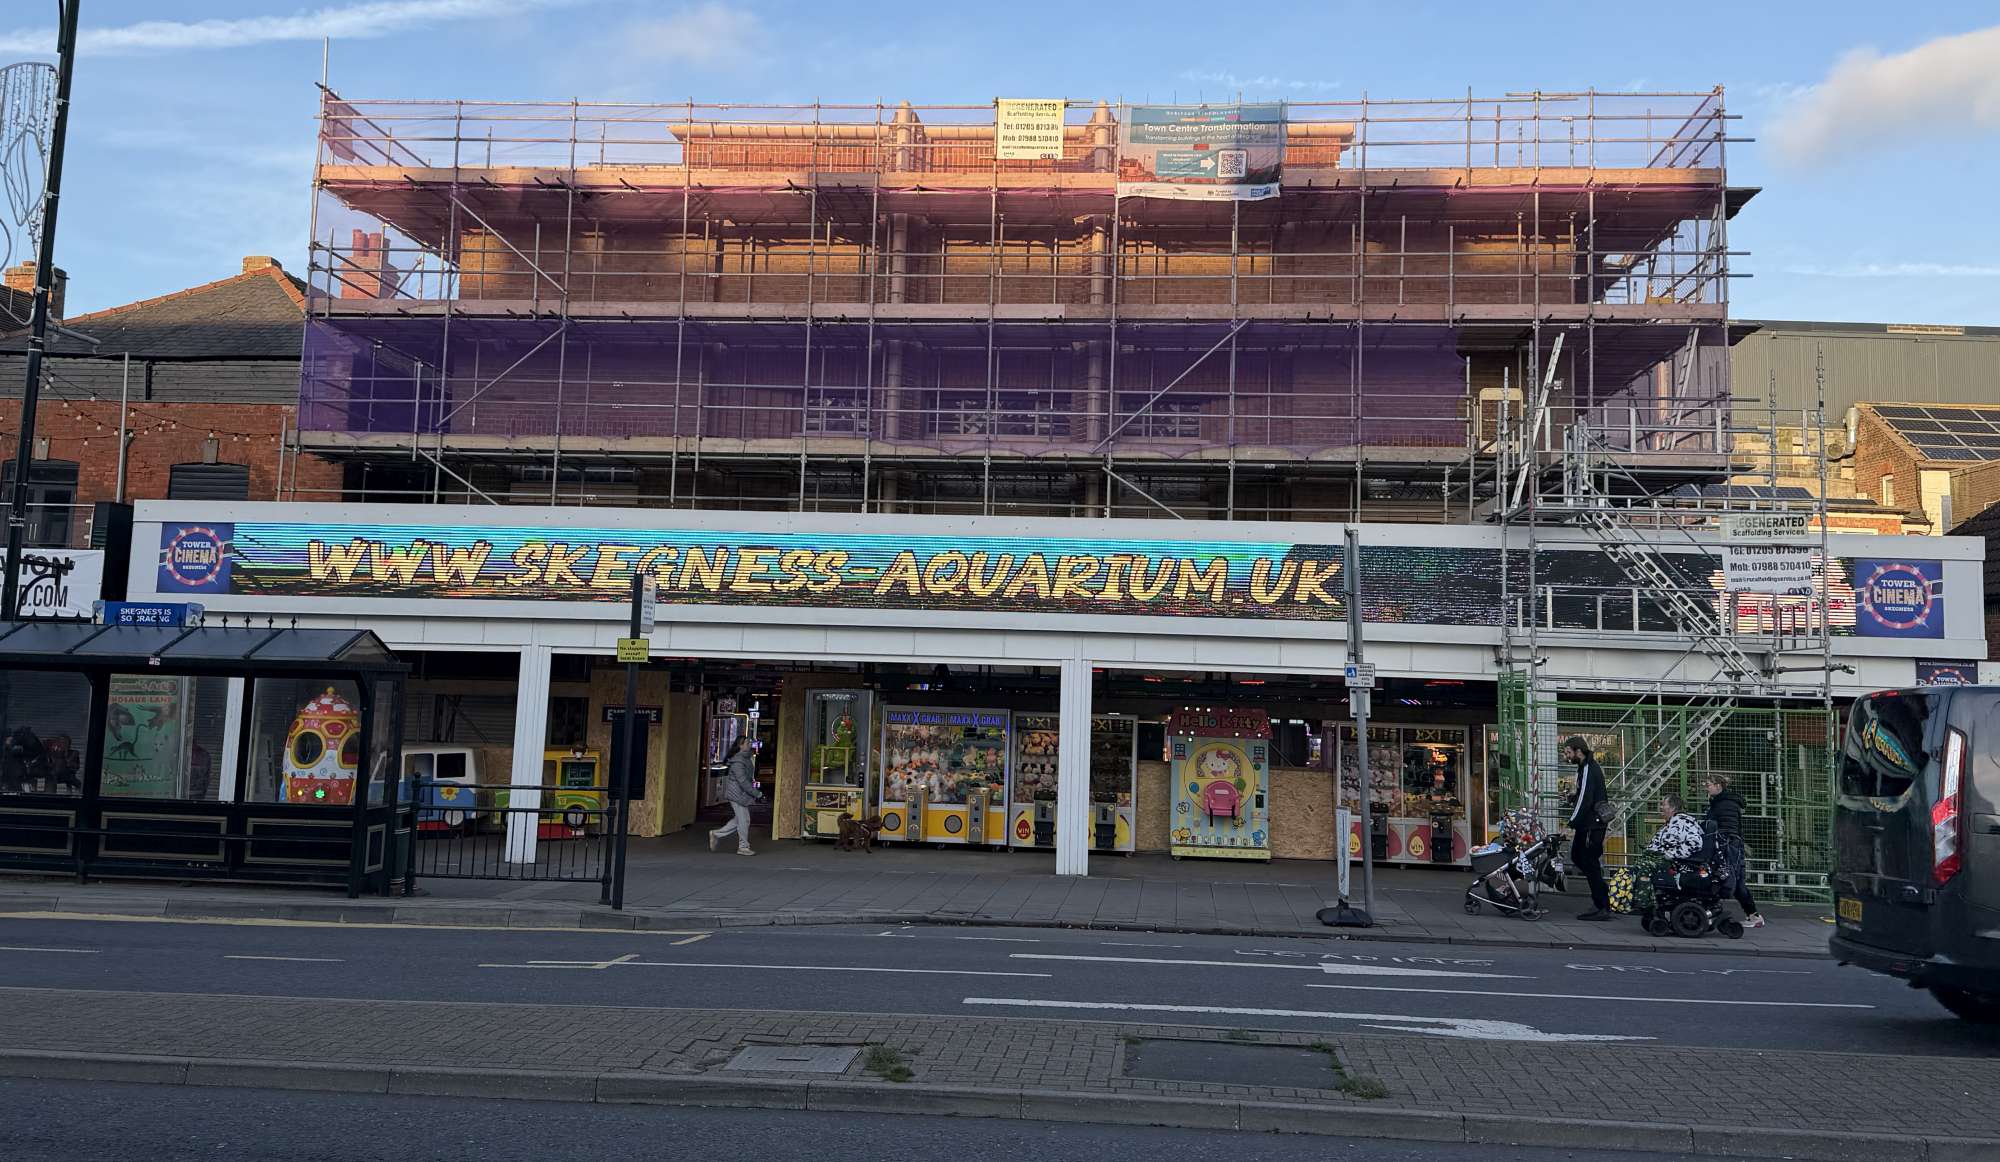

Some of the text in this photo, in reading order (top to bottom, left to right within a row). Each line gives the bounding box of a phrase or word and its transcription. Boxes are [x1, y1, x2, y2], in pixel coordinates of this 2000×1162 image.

[1009, 103, 1057, 111] EGENERATED
[1144, 122, 1265, 133] Town Centre Transformation
[1736, 516, 1805, 528] EGENERATED
[1732, 528, 1805, 537] Scaffolding Services
[182, 541, 212, 549] TOWER
[174, 547, 217, 564] CINEMA
[1730, 561, 1811, 571] Mob: 07988 570410
[1881, 579, 1916, 588] TOWER
[1873, 587, 1925, 605] CINEMA
[164, 608, 172, 616] IS
[136, 615, 170, 623] RACNG
[1180, 714, 1260, 729] Hello Kitty
